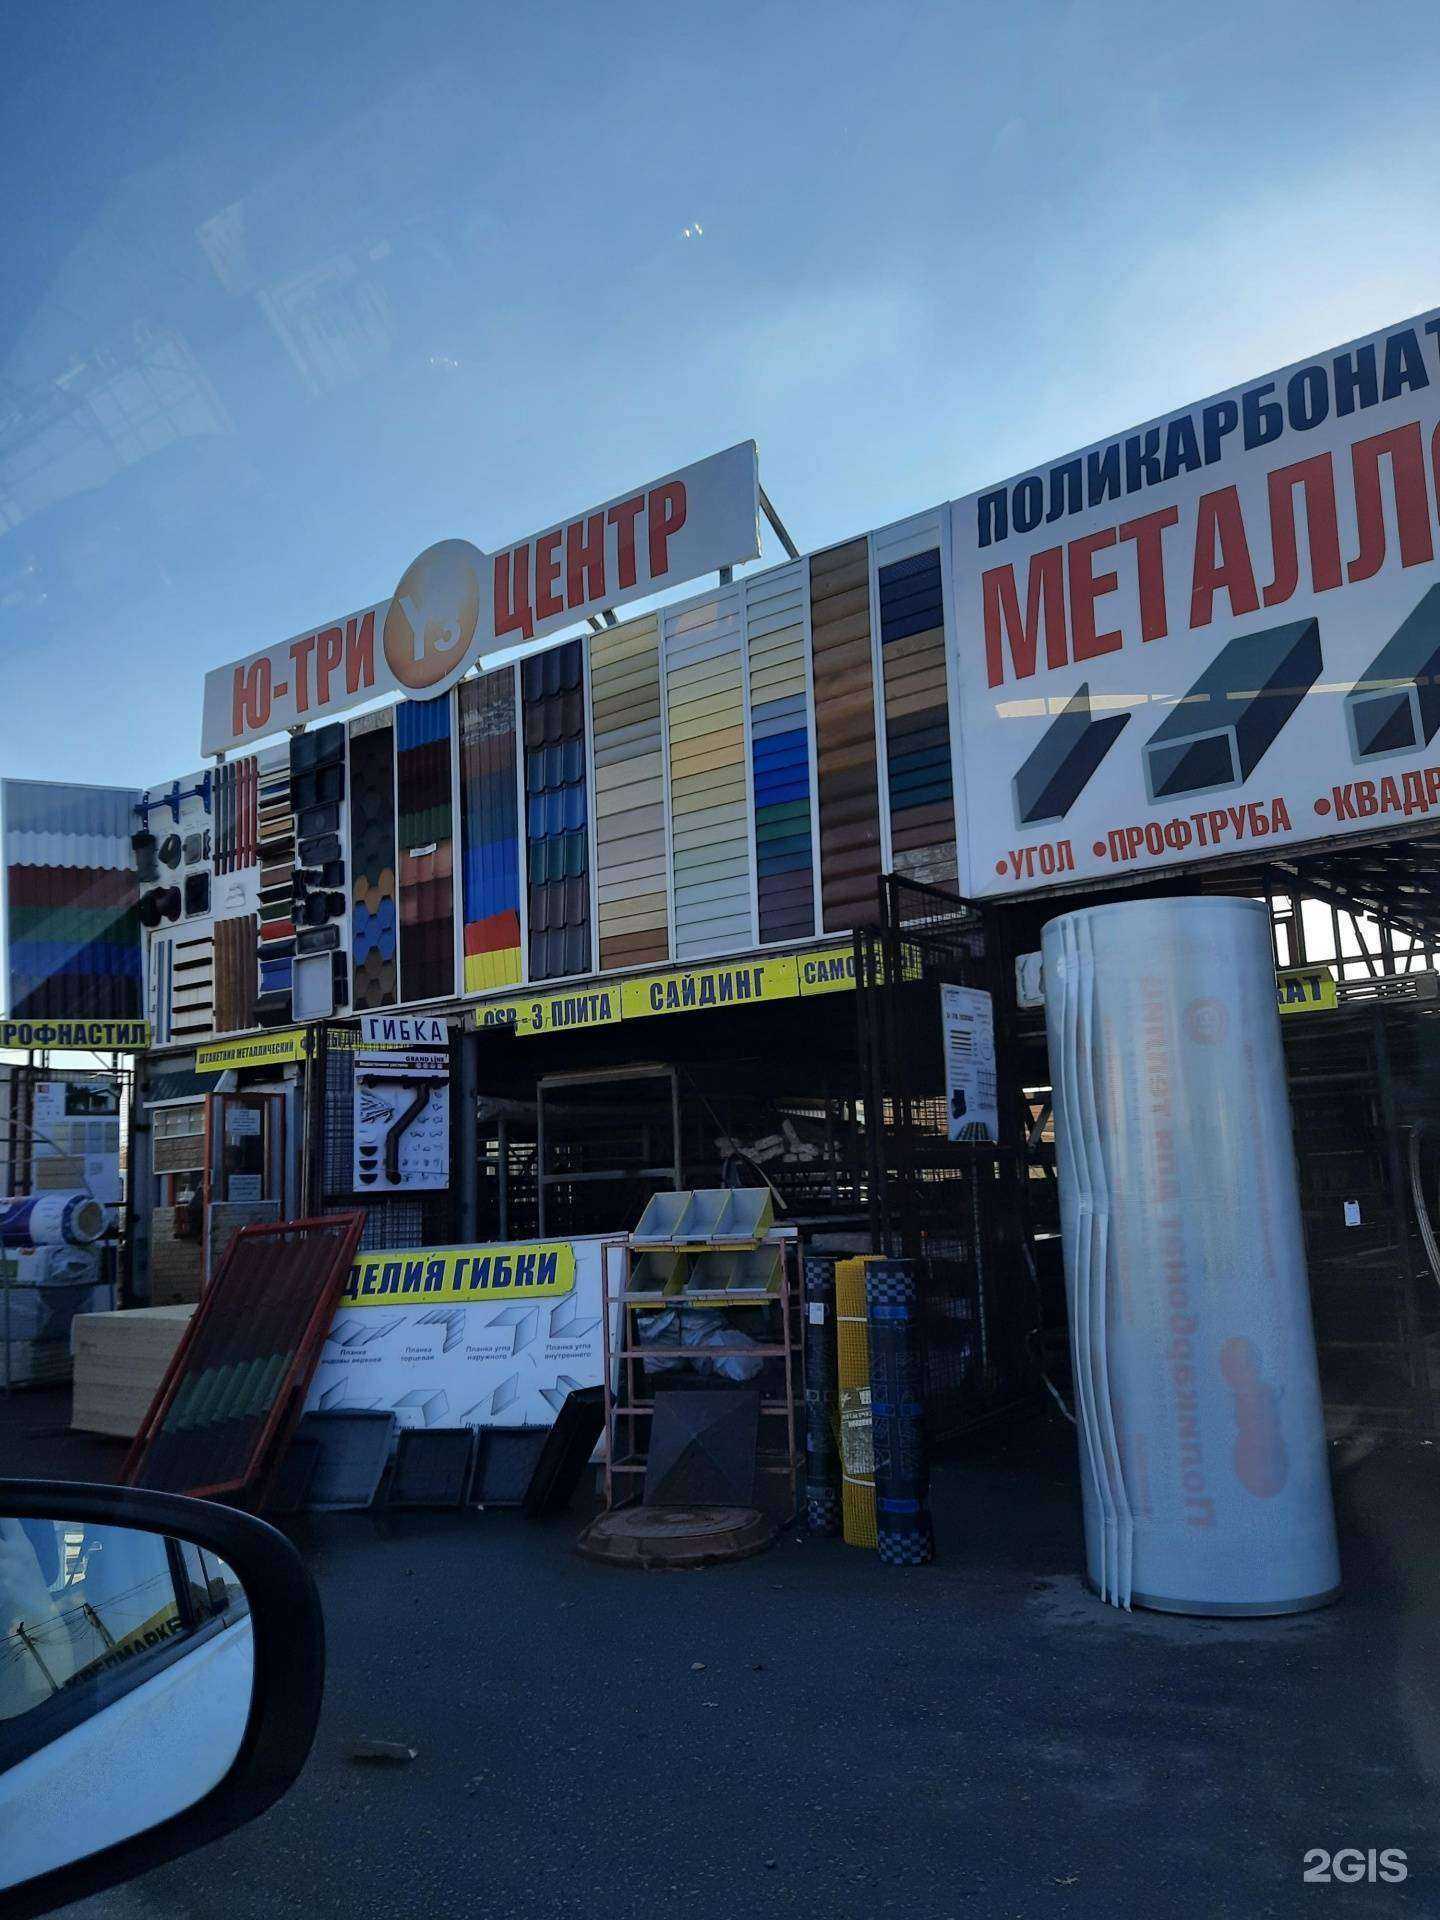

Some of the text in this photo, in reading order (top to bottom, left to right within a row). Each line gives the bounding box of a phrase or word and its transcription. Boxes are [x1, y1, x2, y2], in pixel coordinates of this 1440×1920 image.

[982, 418, 1440, 689] МЕТАЛЛ
[232, 480, 687, 736] Ю-ТРИ ЦЕНТР
[1008, 840, 1076, 880] УГОЛ
[1107, 797, 1292, 863] ПРОФТРУБА
[650, 967, 765, 1011] САЙДИНГ
[1277, 975, 1322, 1004] АТ
[369, 1018, 442, 1041] ГИБКА
[551, 993, 612, 1027] ПЛИТА
[452, 1252, 558, 1291] ГИБКИ
